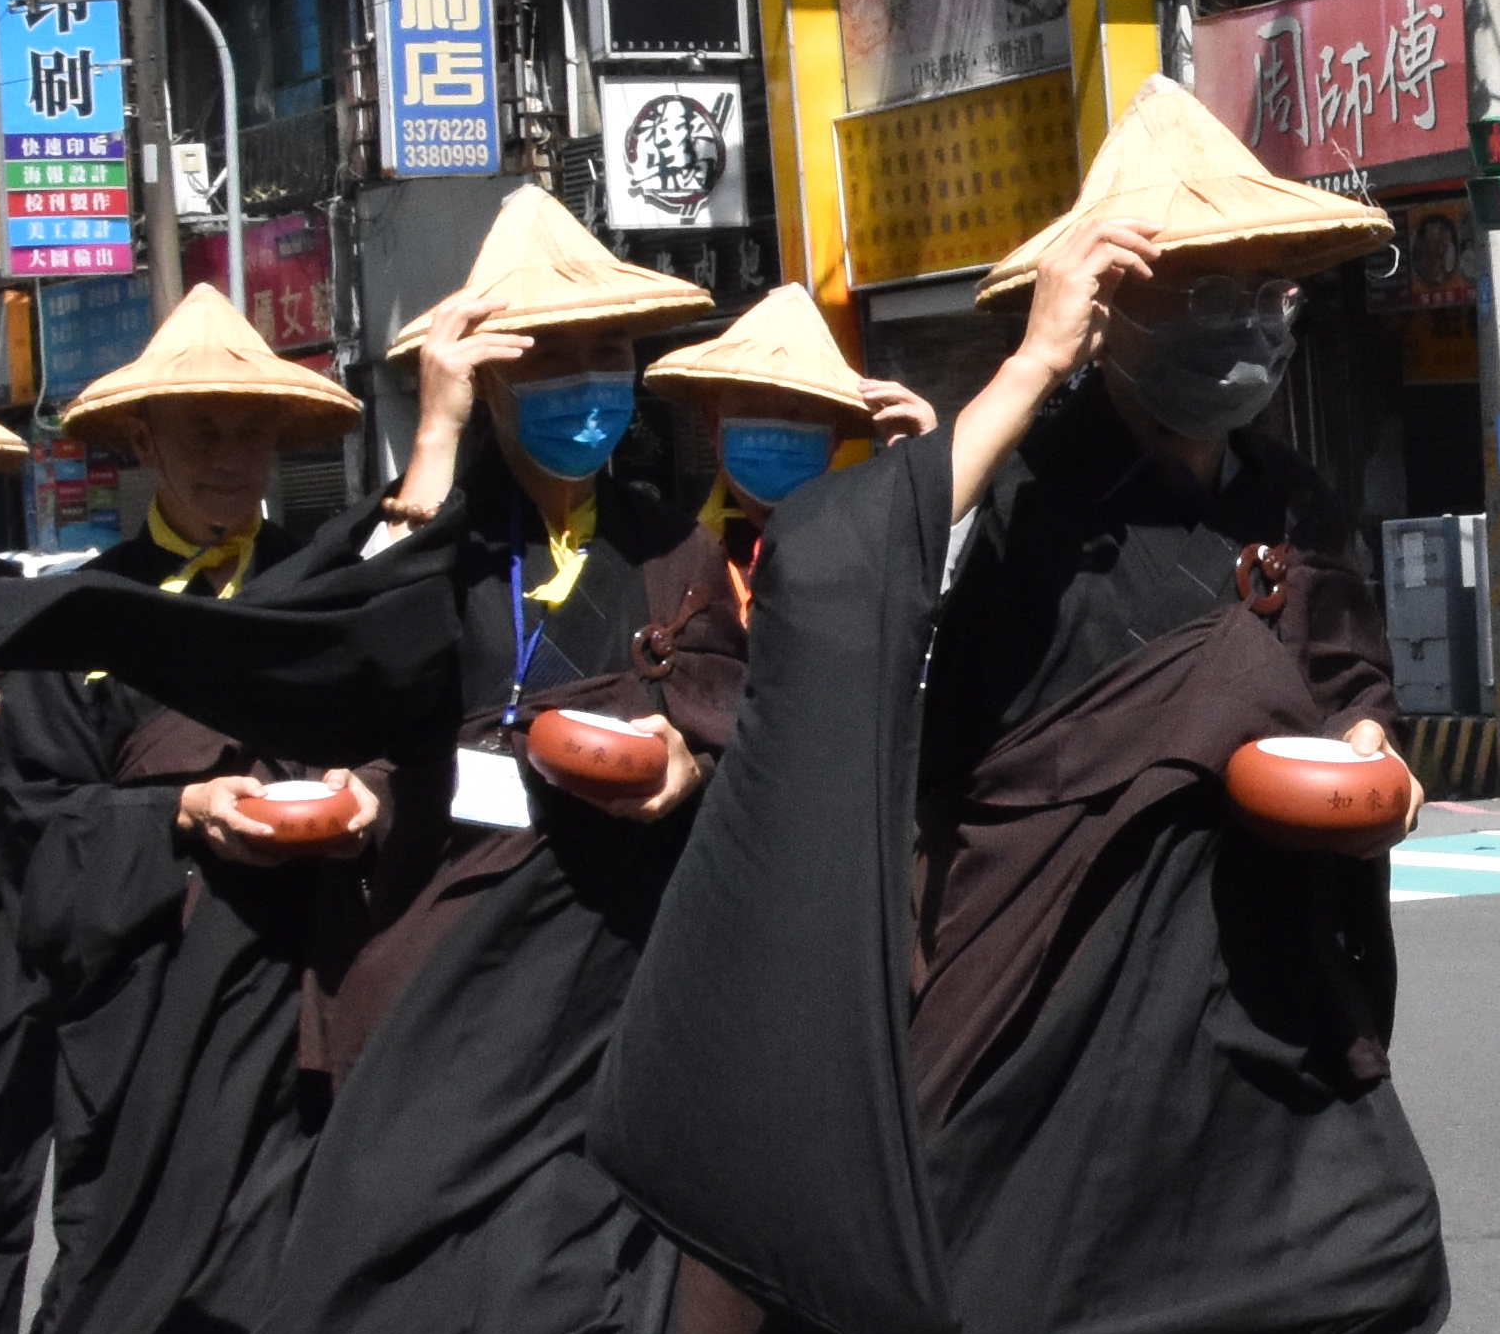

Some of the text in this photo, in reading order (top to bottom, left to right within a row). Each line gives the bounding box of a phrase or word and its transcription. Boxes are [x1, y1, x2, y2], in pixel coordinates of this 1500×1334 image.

[402, 118, 487, 142] 3378228
[404, 144, 489, 168] 3380999
[23, 164, 108, 185] 海報設計
[25, 192, 111, 213] 校刊製作
[28, 220, 111, 241] 美工設計
[29, 247, 114, 269] 大圖輸出
